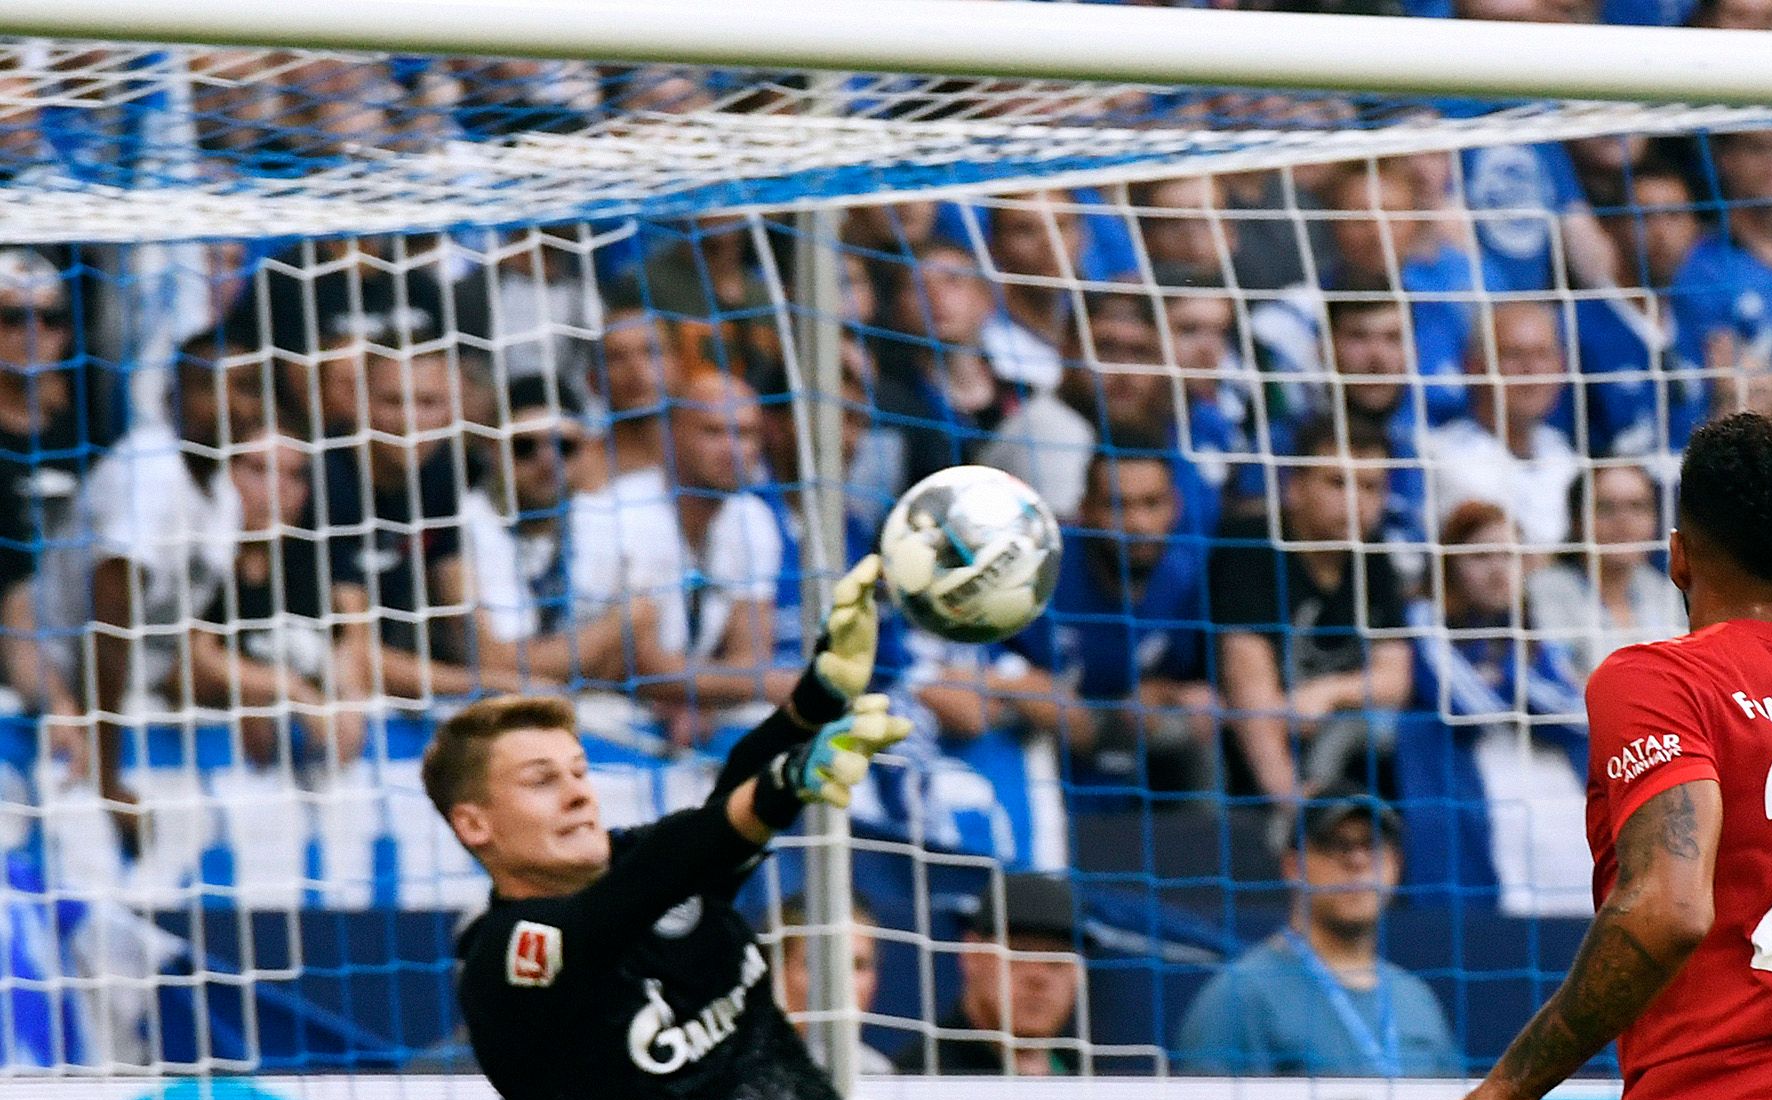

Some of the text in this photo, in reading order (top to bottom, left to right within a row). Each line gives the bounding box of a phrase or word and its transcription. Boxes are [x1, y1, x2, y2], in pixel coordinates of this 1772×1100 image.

[1731, 690, 1769, 720] F
[1606, 733, 1681, 779] QATAR
[1623, 746, 1684, 784] AIRWAYS
